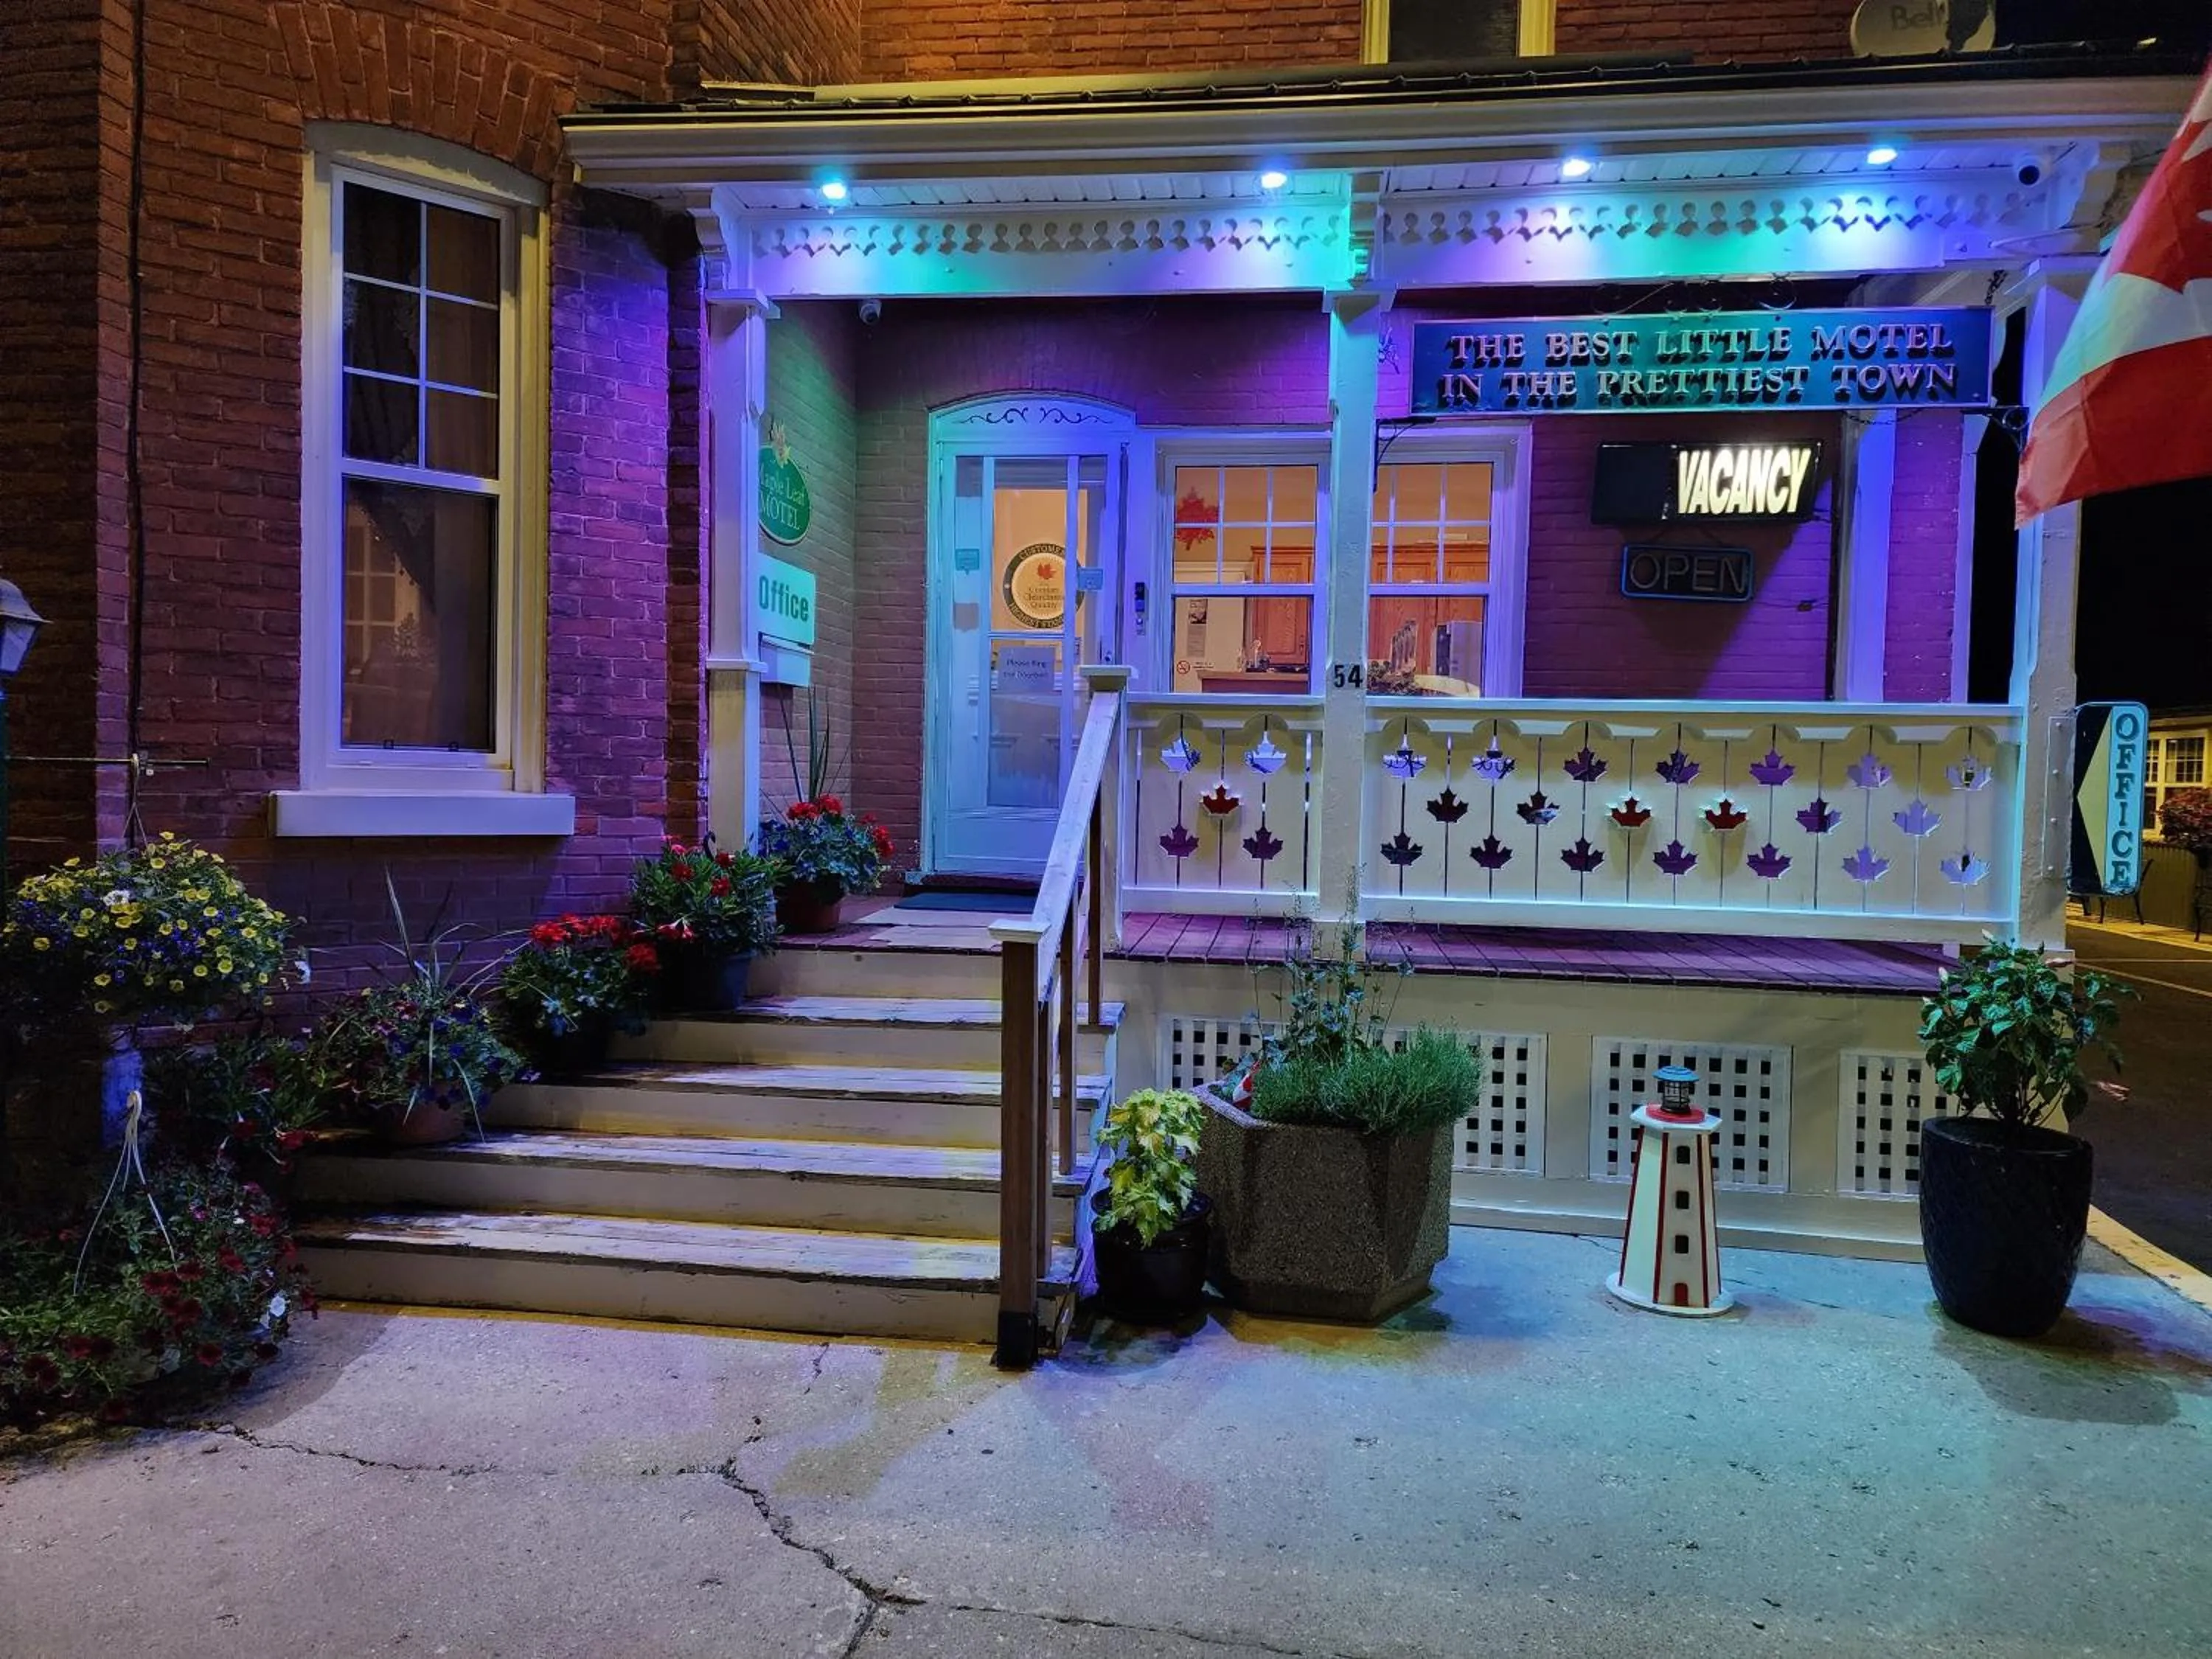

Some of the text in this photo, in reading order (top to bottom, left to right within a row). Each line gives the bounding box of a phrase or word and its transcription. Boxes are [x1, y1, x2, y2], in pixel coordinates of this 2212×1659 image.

[1450, 323, 1952, 361] THE BEST LITTLE MOTEL
[1441, 364, 1957, 398] IN THE PRETTIEST TOWN
[1677, 447, 1812, 515] VACANCY
[1629, 553, 1747, 594] OPEN
[759, 575, 810, 623] Office
[1333, 664, 1363, 688] 54
[2110, 712, 2140, 886] OFFICE
